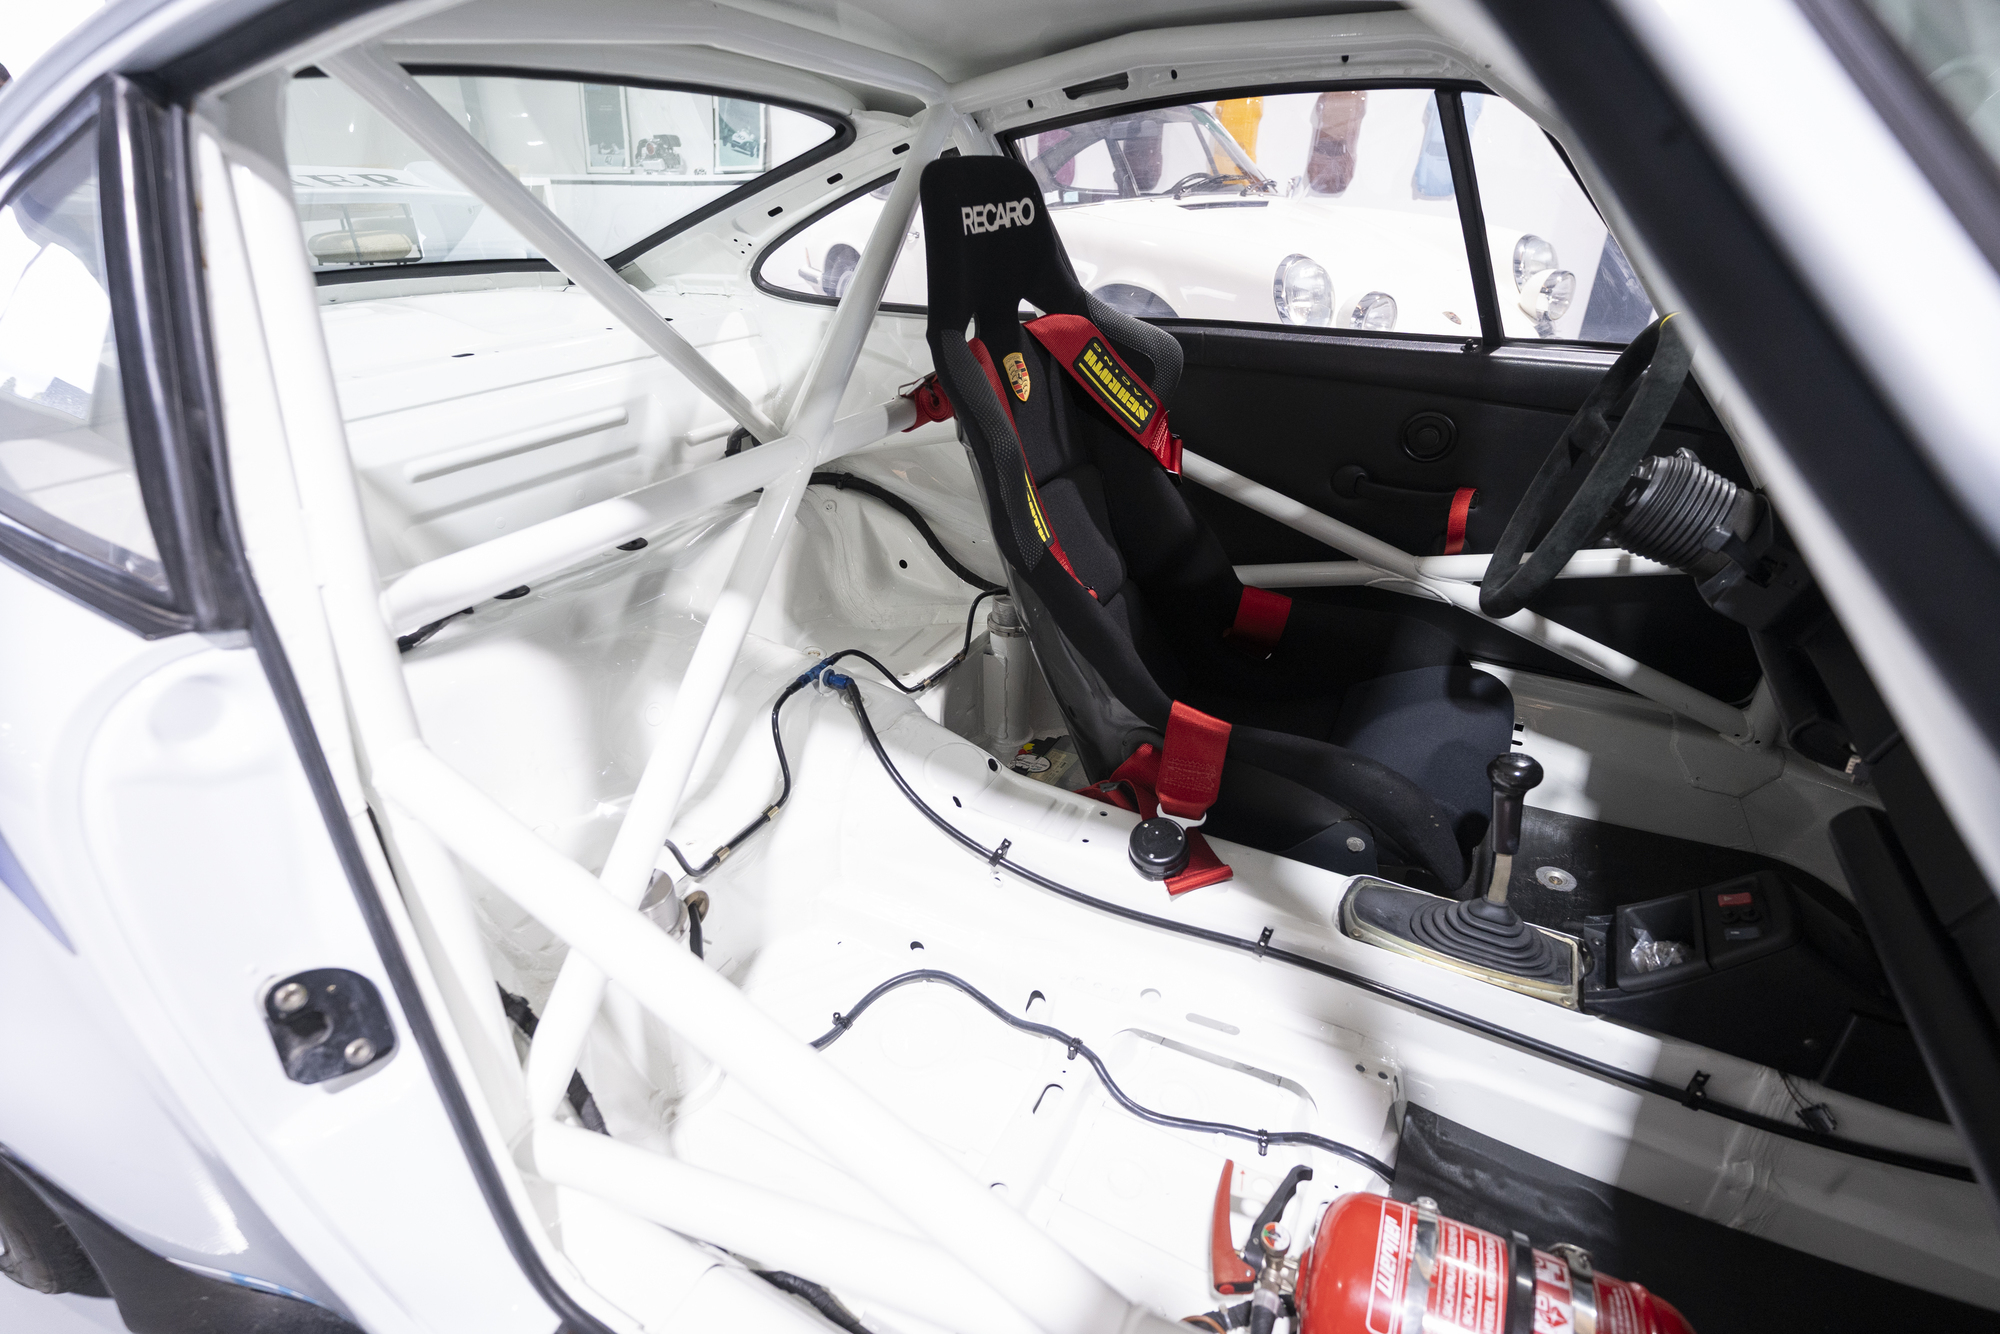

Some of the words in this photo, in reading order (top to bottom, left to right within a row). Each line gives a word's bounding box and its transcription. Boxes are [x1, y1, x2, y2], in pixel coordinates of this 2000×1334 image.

[961, 197, 1035, 236] RECARO
[1083, 349, 1149, 421] SCHROTH
[1093, 343, 1153, 409] RACING
